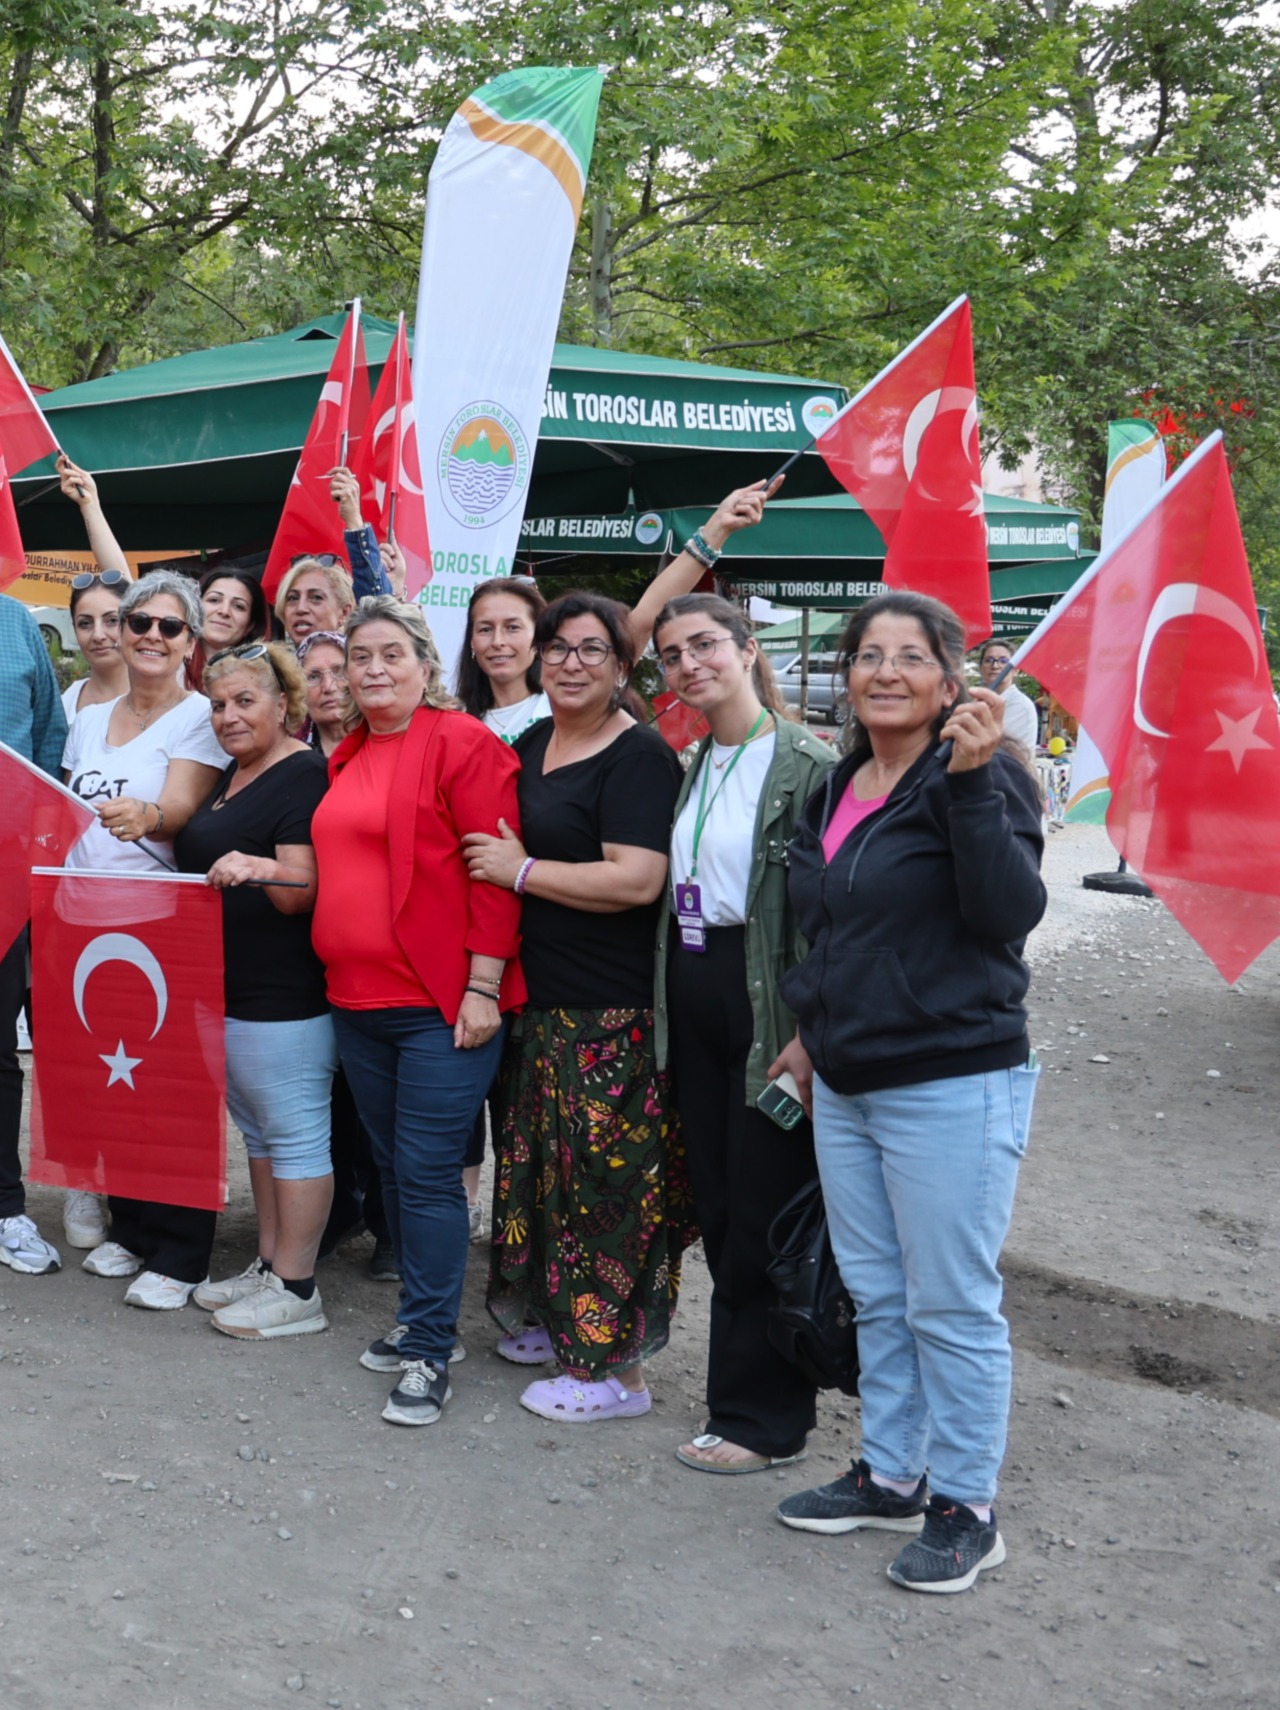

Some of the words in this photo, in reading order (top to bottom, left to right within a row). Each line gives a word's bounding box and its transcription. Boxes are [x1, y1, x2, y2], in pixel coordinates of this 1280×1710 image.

[455, 404, 503, 427] TOROSLAR
[572, 392, 678, 429] TOROSLAR
[683, 398, 797, 432] BELEDİYESİ
[463, 513, 485, 526] 1994
[558, 515, 635, 538] BELEDİYESİ
[431, 550, 513, 577] OROSLA
[780, 582, 843, 597] TOROSLAR
